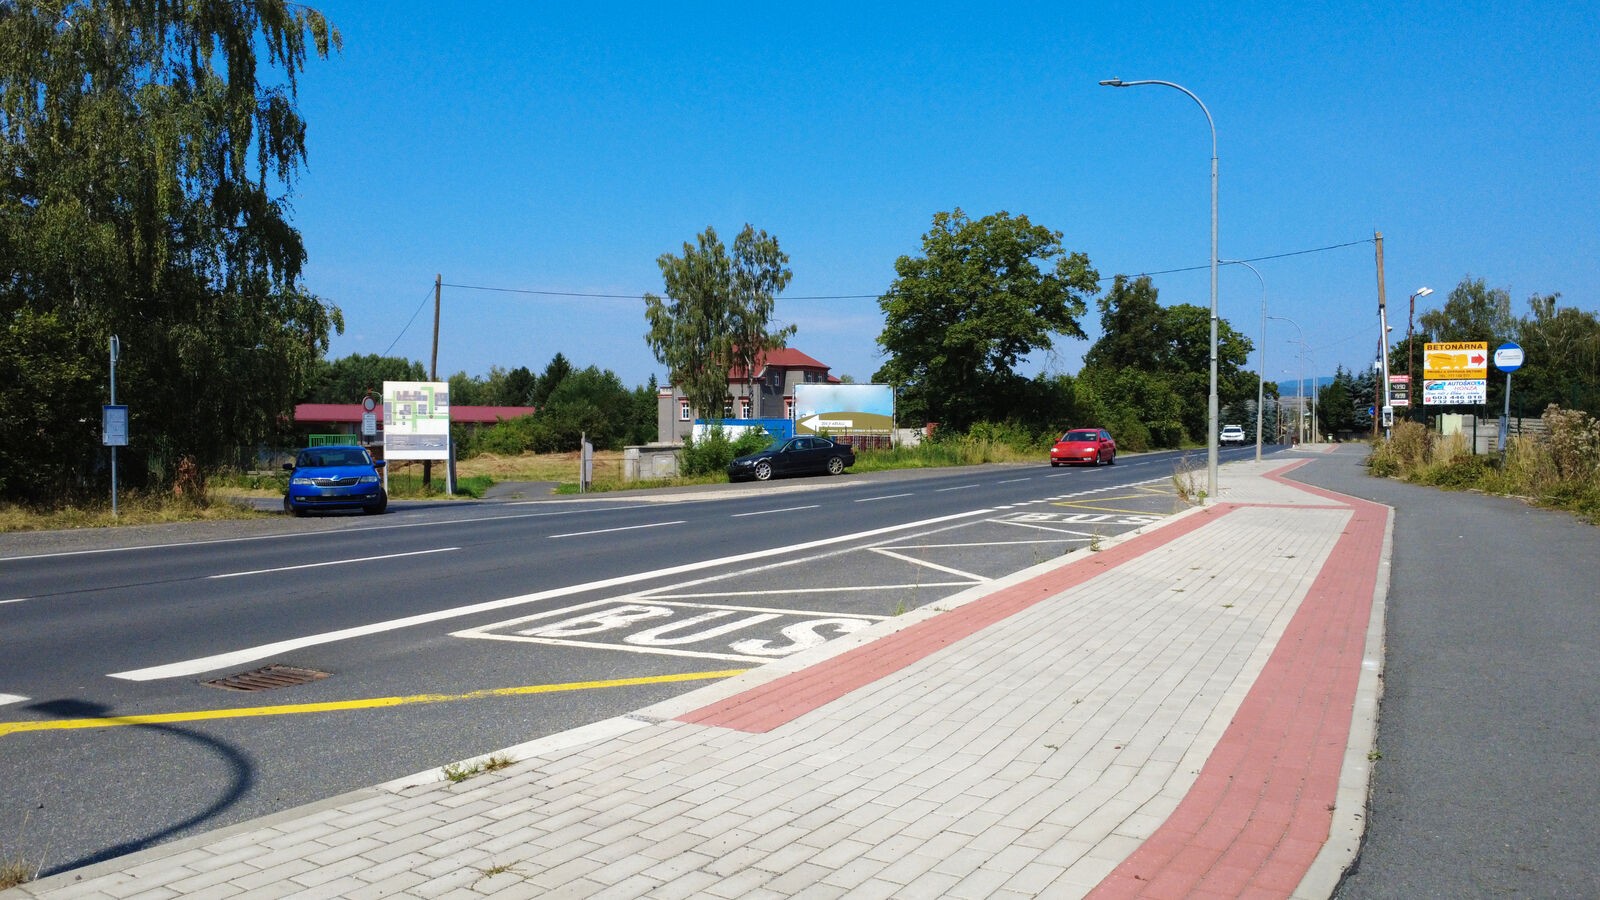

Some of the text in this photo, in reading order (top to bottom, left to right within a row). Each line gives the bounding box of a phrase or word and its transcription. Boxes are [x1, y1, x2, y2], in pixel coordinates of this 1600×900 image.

[1427, 343, 1483, 351] BETONÁRNA
[1011, 512, 1164, 525] BUS
[516, 603, 874, 656] BUS
